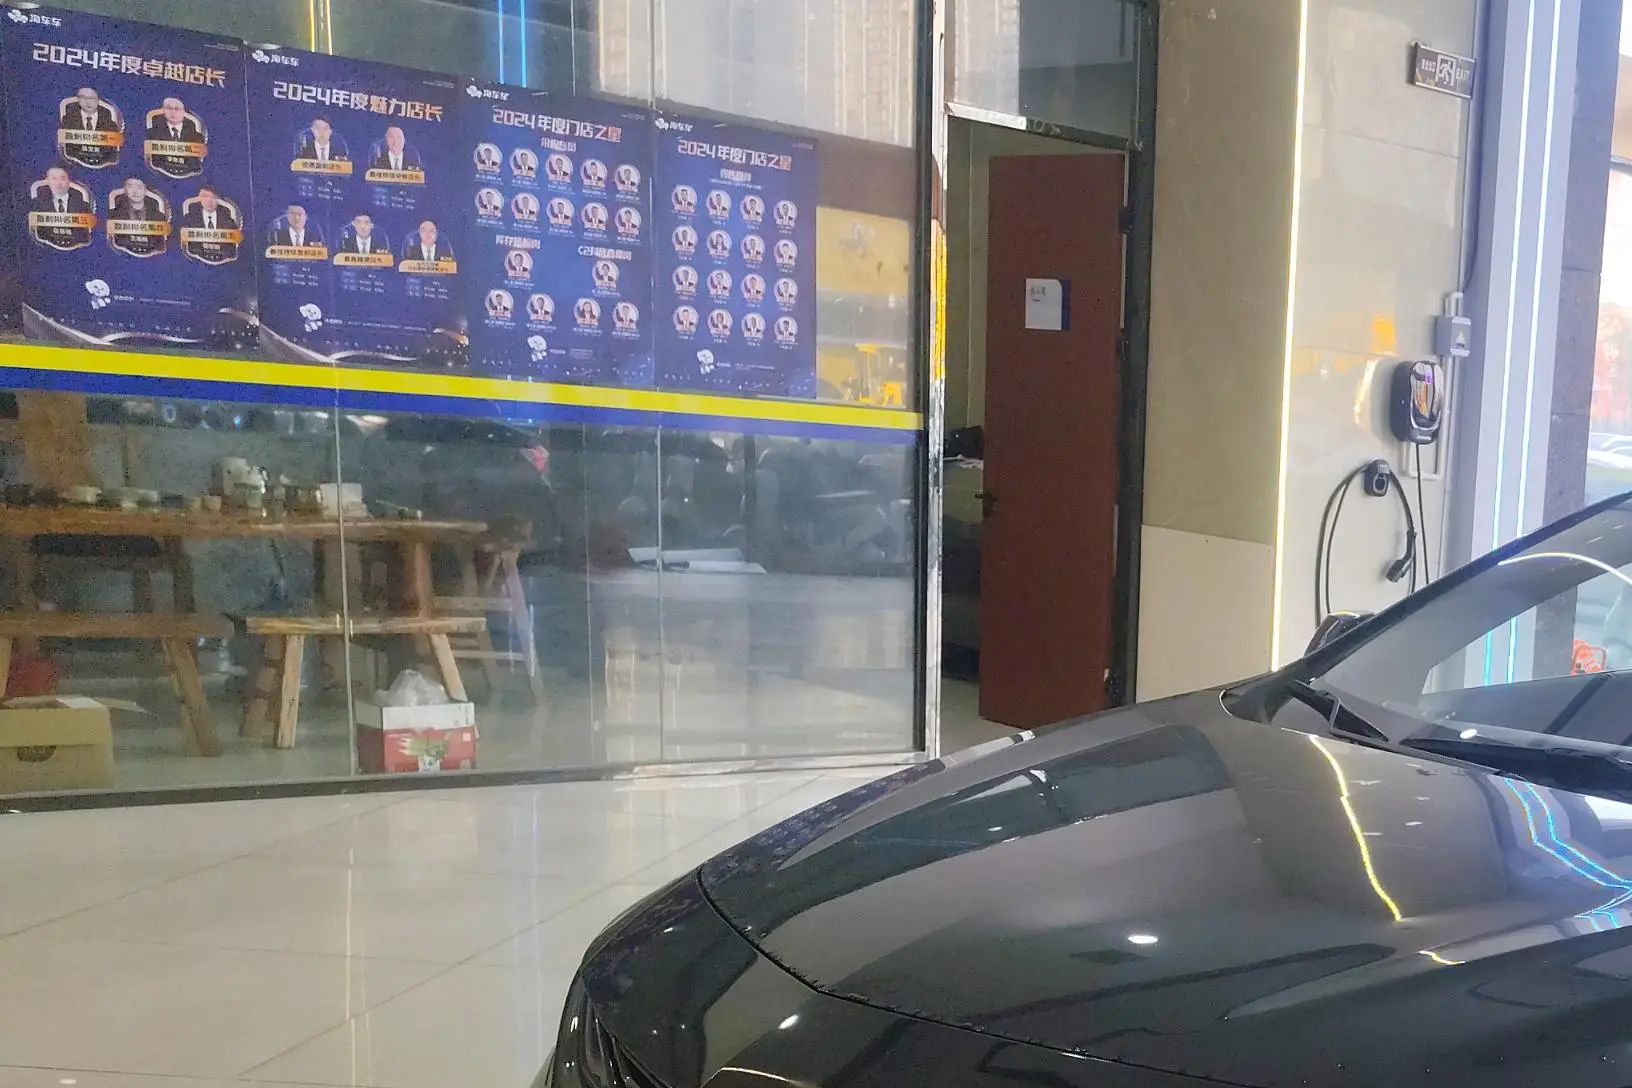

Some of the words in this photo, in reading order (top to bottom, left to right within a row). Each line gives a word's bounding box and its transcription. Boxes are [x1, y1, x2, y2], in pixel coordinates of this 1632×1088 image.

[33, 42, 226, 88] 2024年度卓越店长
[273, 80, 444, 123] 2024年度魅力店长
[492, 108, 535, 129] 2024
[537, 114, 622, 143] 年度门店之星
[677, 139, 716, 159] 2024
[717, 144, 792, 171] 年度门店之星
